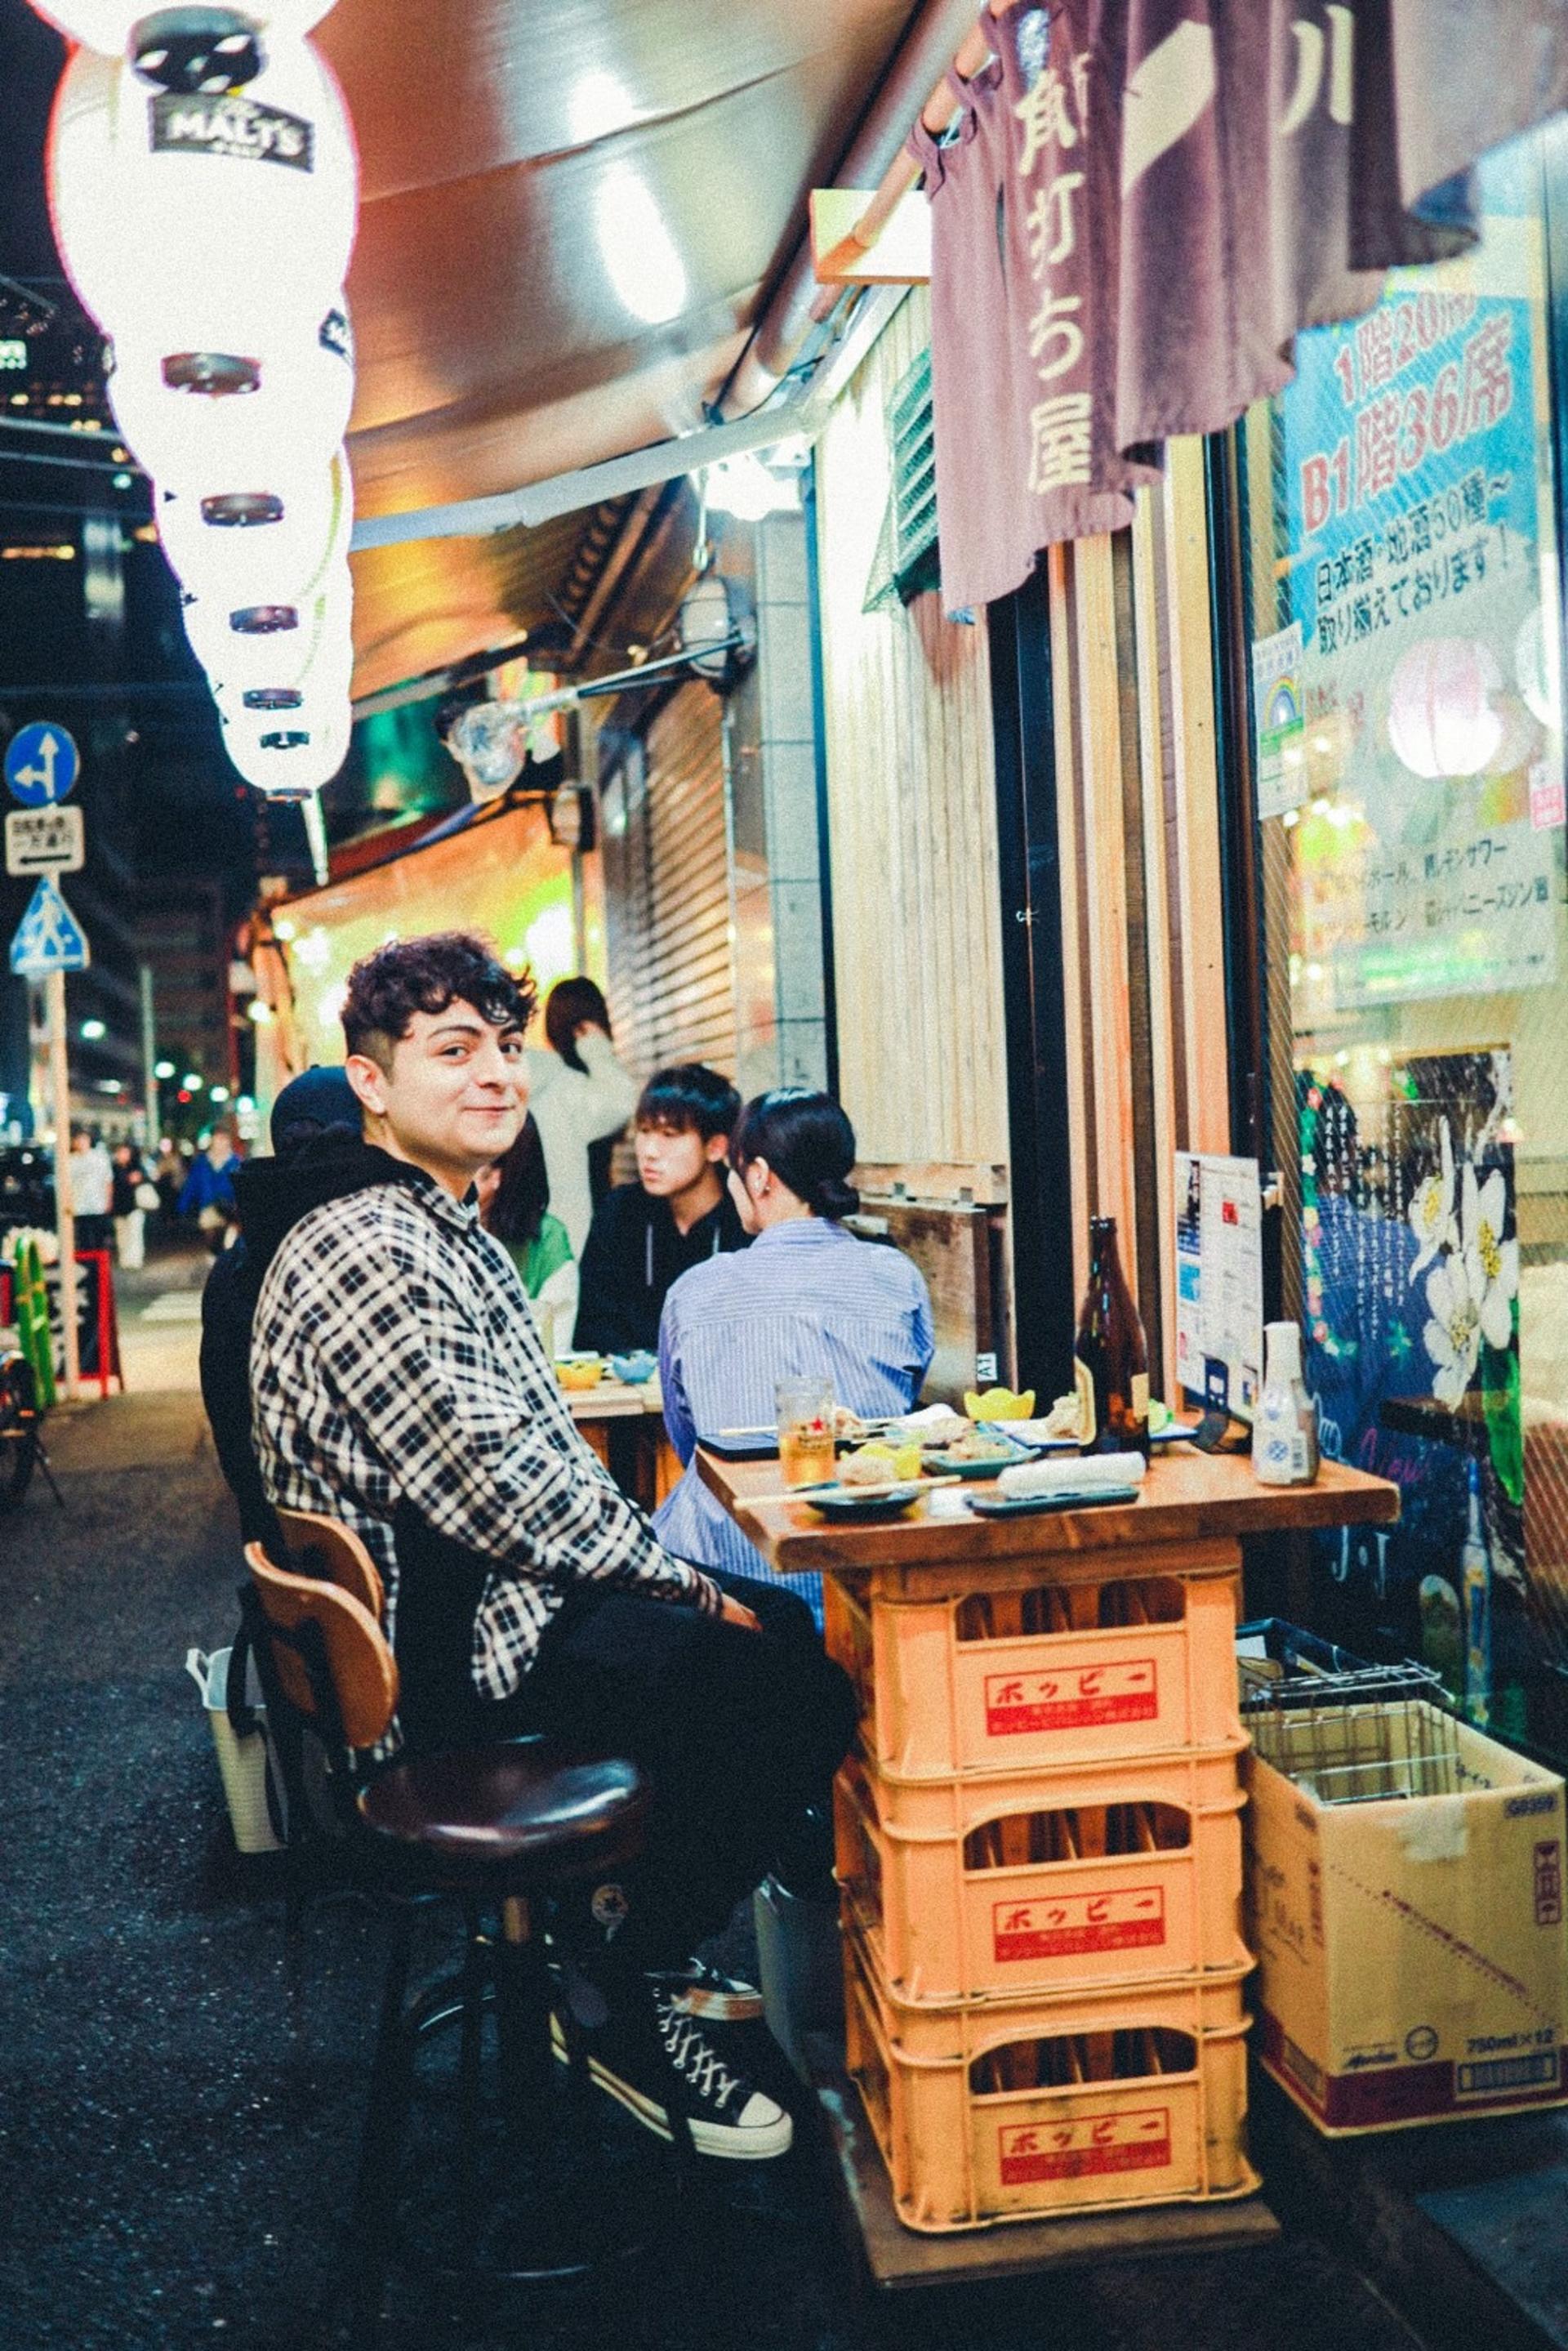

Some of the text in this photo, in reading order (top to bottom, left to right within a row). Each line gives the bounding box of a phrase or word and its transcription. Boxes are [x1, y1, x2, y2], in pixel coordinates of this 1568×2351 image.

[1302, 314, 1512, 533] B1階36席
[996, 1669, 1147, 1705] ホッピー
[1004, 1895, 1154, 1931] ホッピー
[1010, 2118, 1160, 2154] ホッピー
